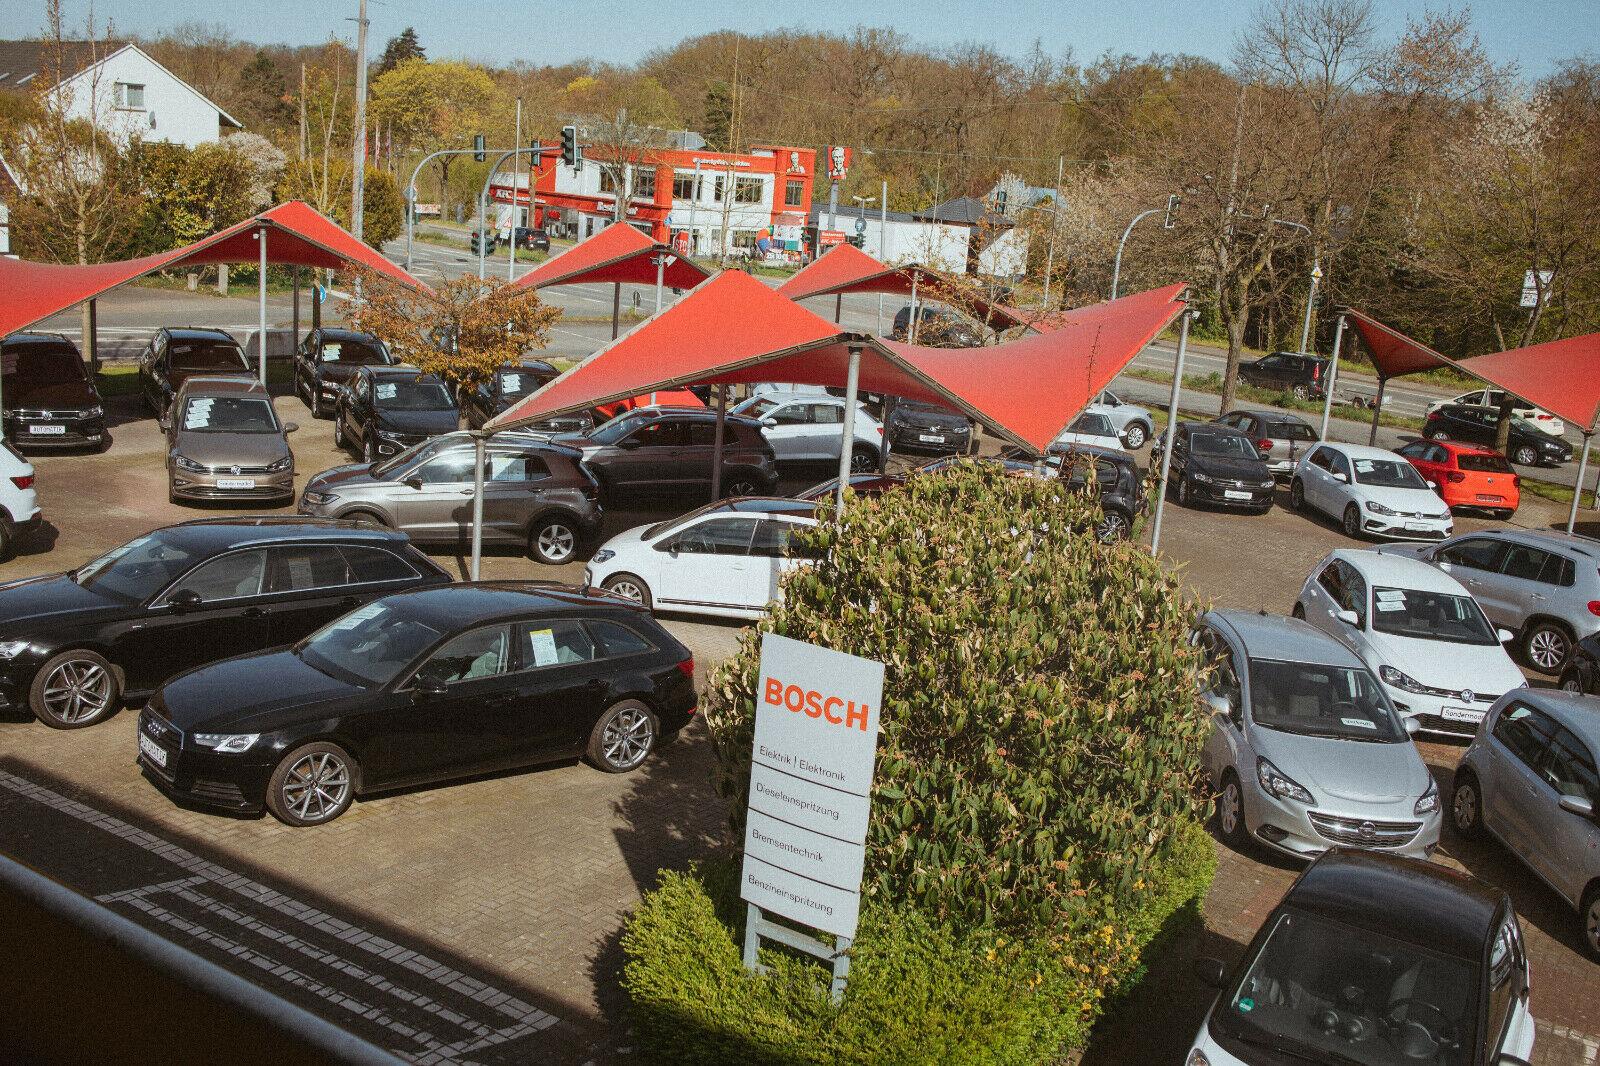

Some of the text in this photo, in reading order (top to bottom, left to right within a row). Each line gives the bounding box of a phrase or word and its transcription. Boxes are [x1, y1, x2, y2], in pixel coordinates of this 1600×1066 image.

[765, 677, 869, 731] BOSCH
[760, 745, 791, 765] Elektrik
[800, 760, 846, 782] Elektronik
[756, 782, 839, 820] Dieseleinspritzung
[752, 829, 823, 862] Bremsentechnik
[748, 874, 833, 916] Benzineinspritzung
